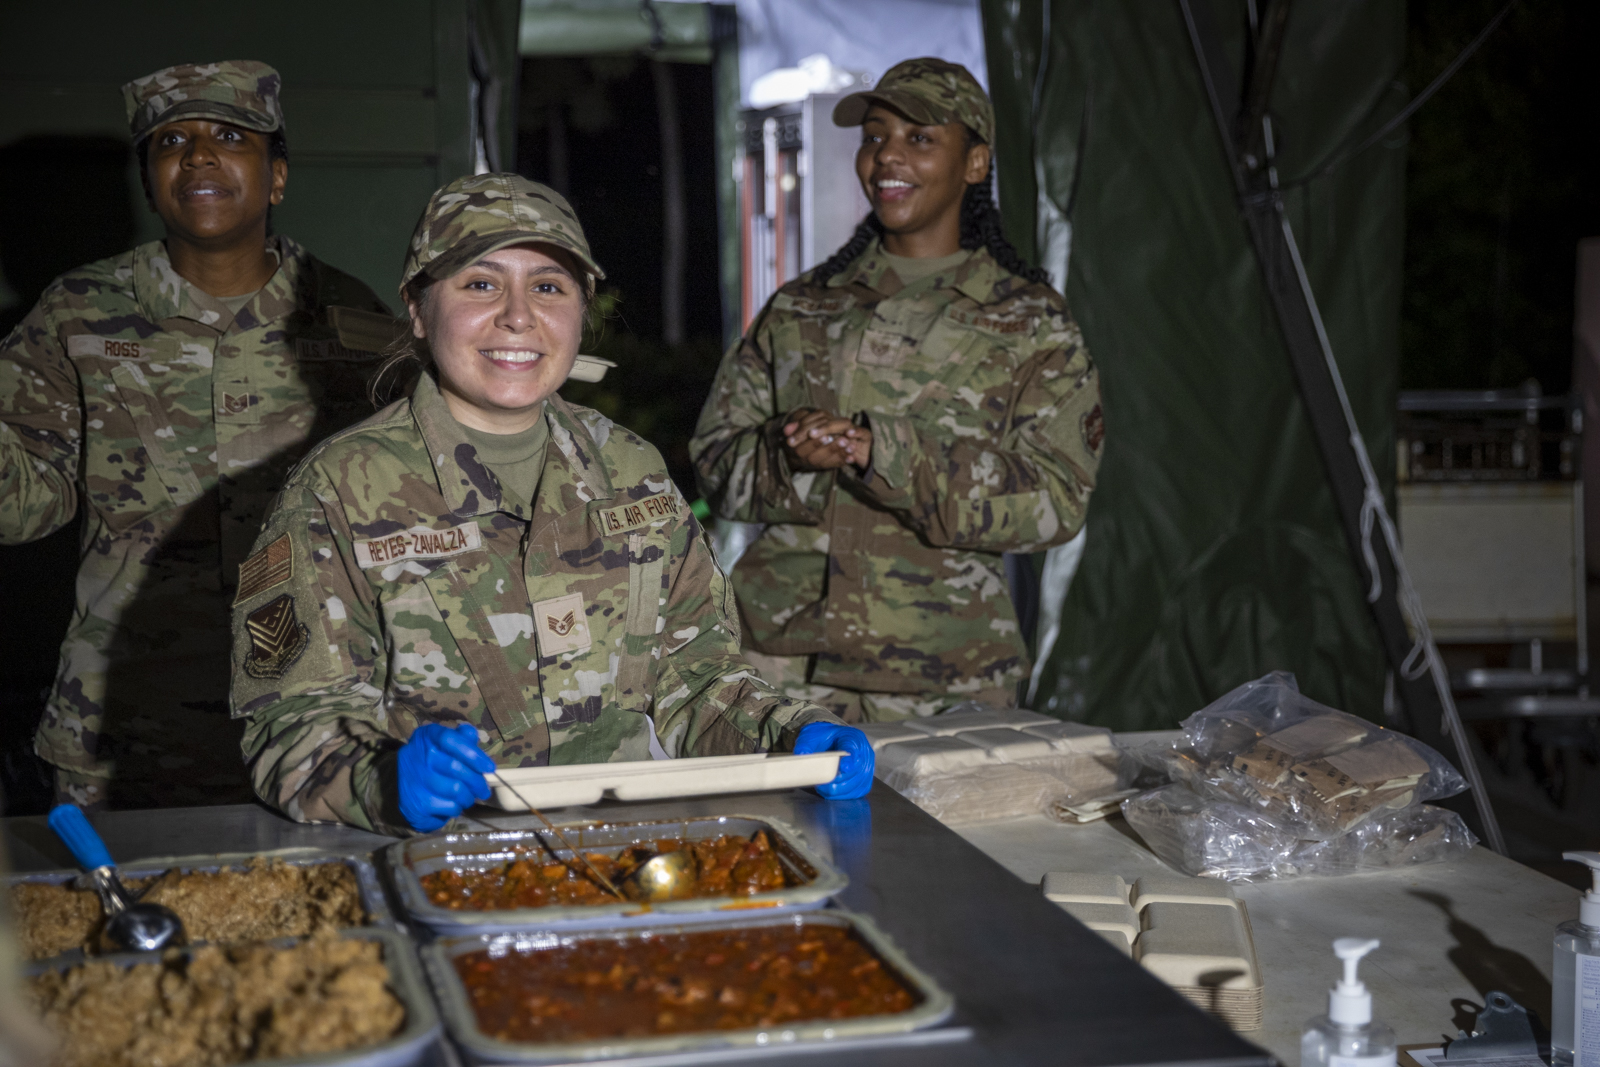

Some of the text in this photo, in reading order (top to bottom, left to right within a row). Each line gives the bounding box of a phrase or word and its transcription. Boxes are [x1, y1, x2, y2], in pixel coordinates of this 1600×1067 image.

[104, 340, 140, 358] ROSS
[604, 511, 624, 531] U.S.
[624, 505, 646, 526] AIR
[367, 527, 469, 563] REYES-ZAVALZA
